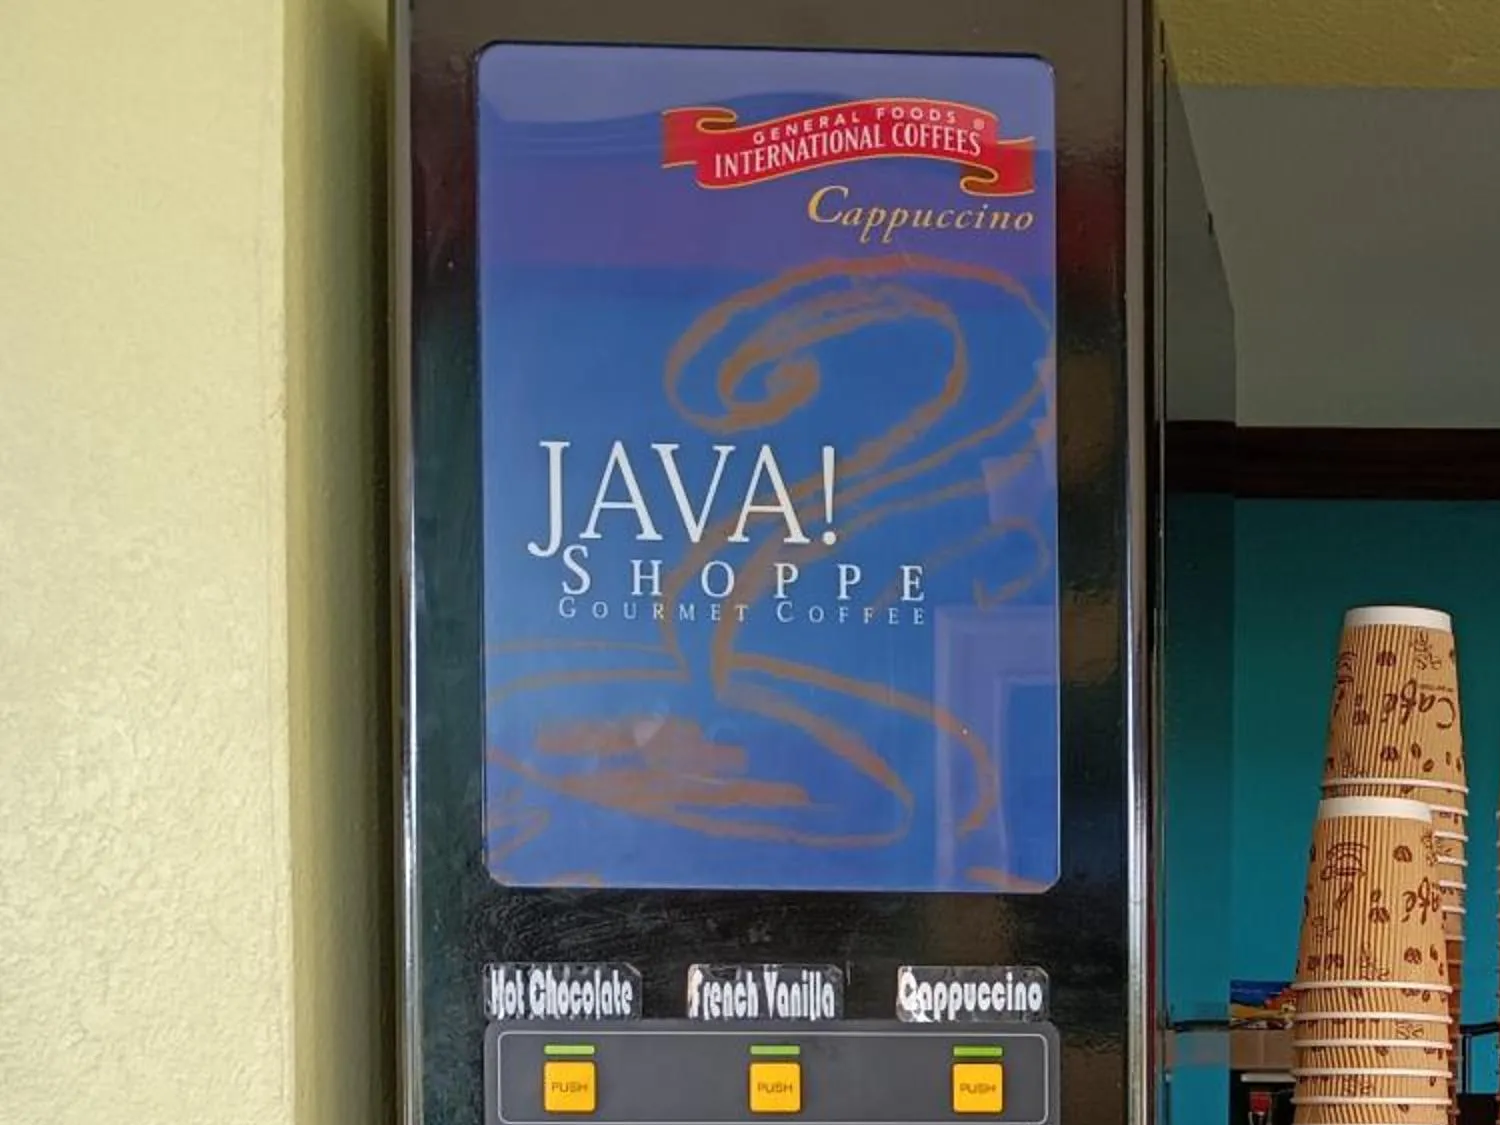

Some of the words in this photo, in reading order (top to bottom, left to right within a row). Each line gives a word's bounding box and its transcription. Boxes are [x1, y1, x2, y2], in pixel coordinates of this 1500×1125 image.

[714, 125, 886, 178] INTERNATIONAL
[891, 119, 982, 157] COFFEES
[753, 113, 860, 145] GENERAL
[876, 107, 957, 125] FOODS
[807, 185, 1035, 243] Cappuccino
[527, 439, 838, 558] JAVA!
[561, 544, 926, 601] SHOPPE
[558, 596, 750, 622] GOURMET
[776, 600, 926, 626] COFFEE
[491, 967, 524, 1019] Hot
[529, 965, 634, 1019] Chocolate
[688, 963, 759, 1019] French
[763, 967, 836, 1021] Vanilla
[898, 966, 1044, 1022] Cappuccino
[550, 1081, 589, 1093] PUSH
[757, 1082, 793, 1094] PUSH
[959, 1083, 997, 1094] PUSH
